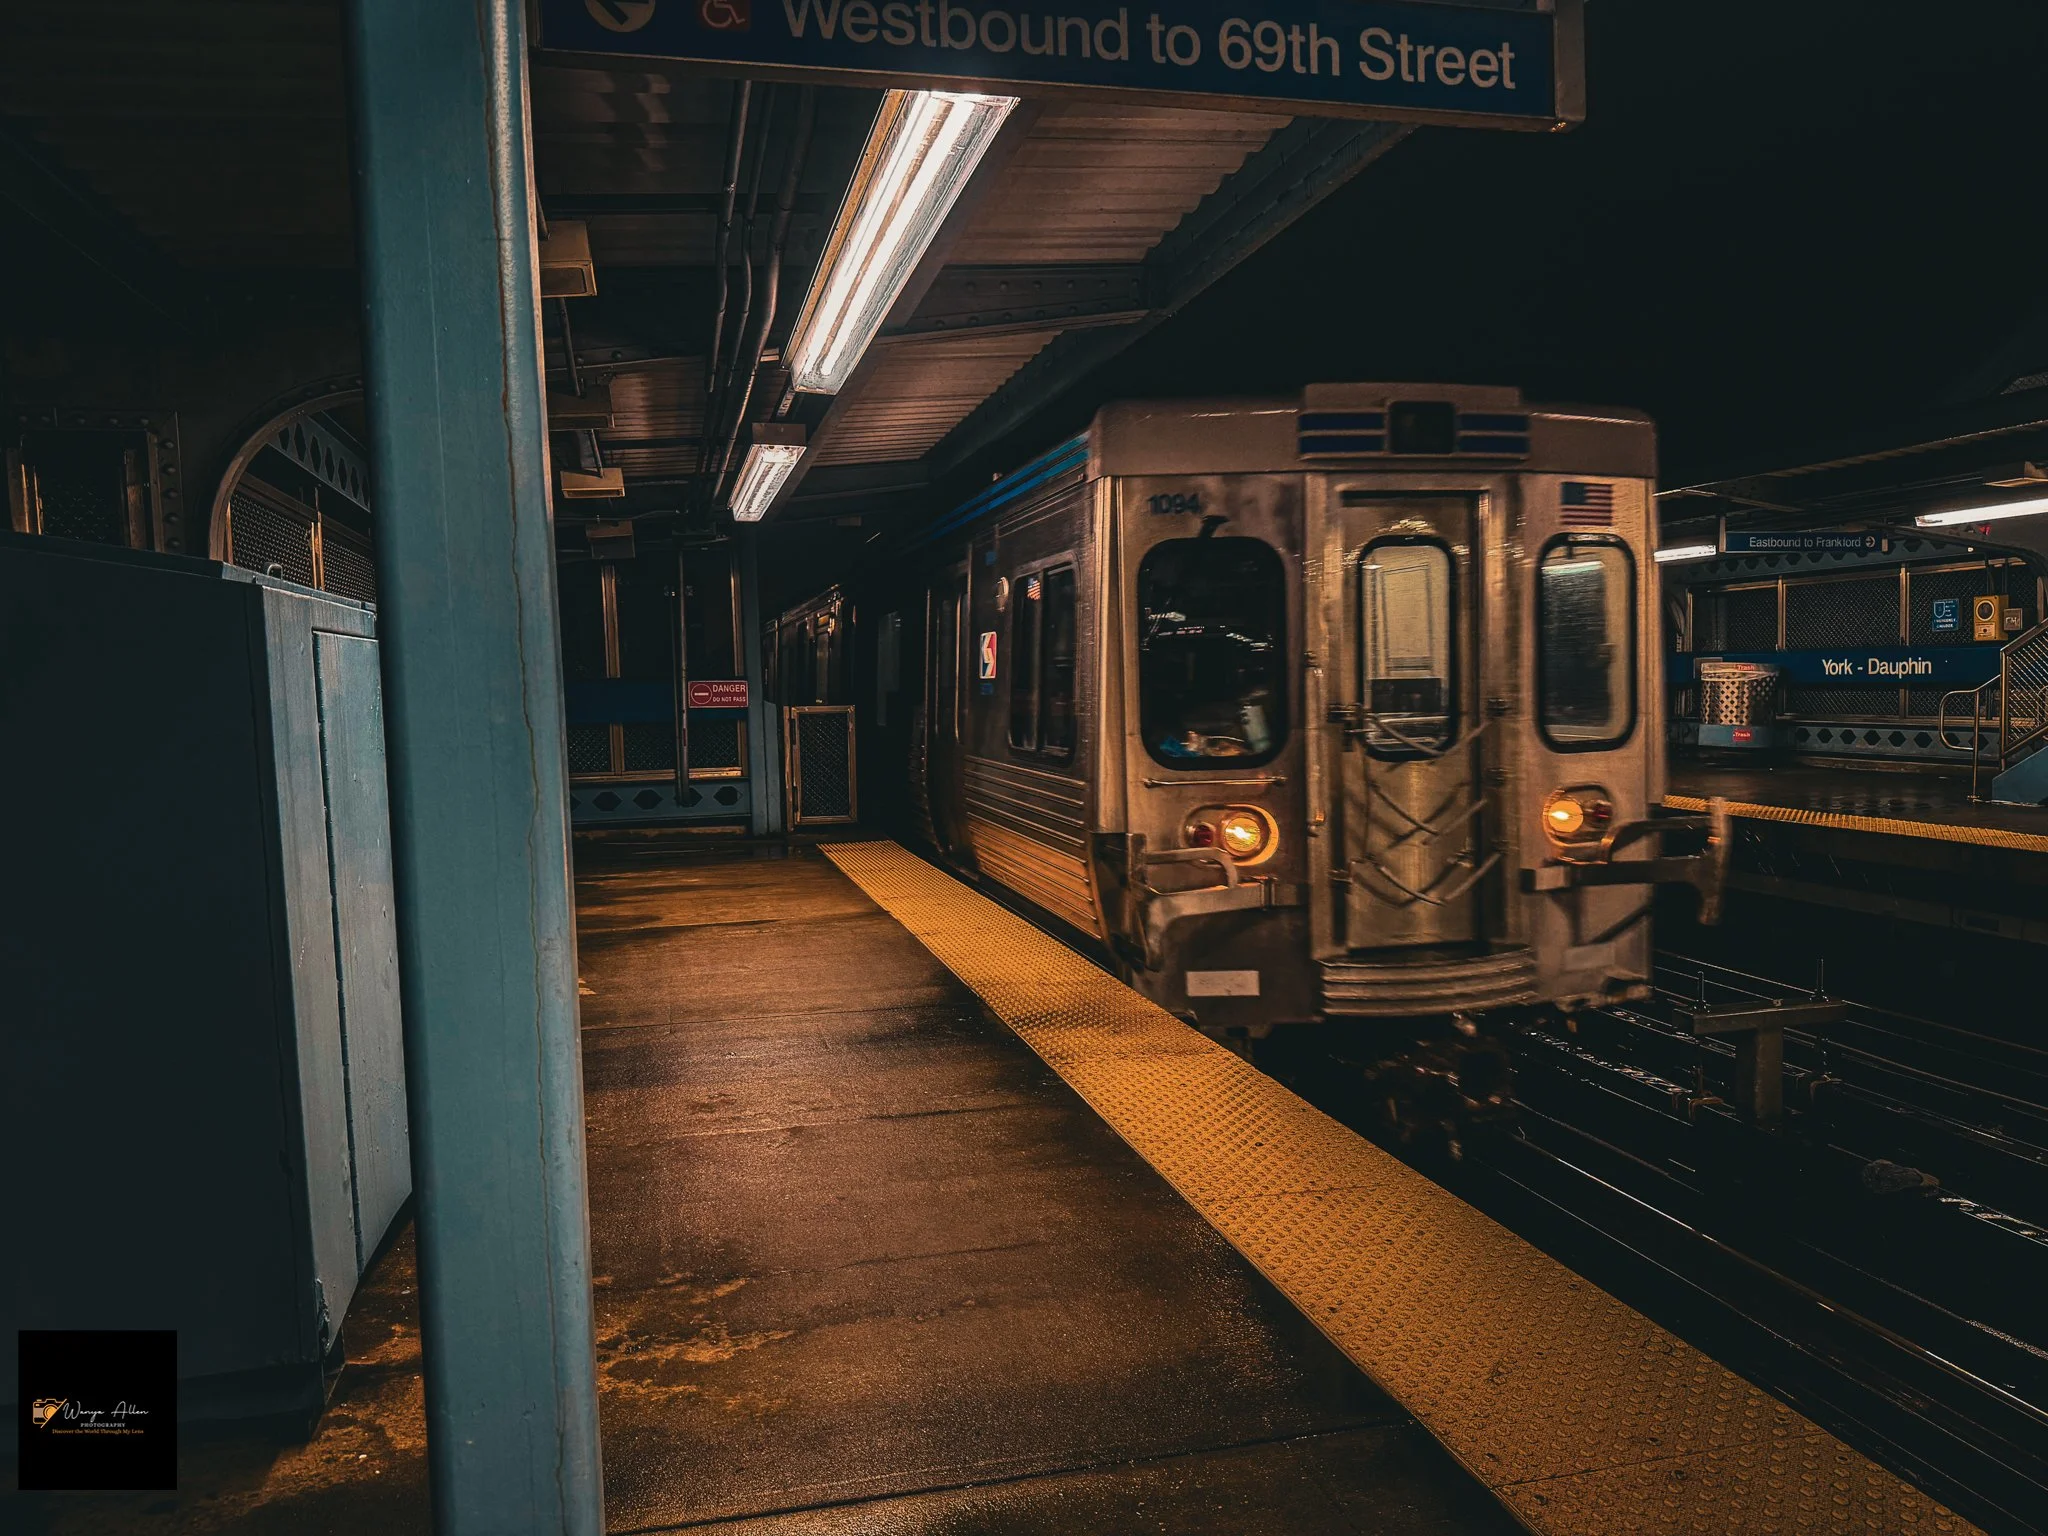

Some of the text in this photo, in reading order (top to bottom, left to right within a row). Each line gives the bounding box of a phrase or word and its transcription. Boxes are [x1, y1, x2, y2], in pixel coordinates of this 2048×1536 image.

[783, 0, 1516, 90] Westbound to 69th Street
[1146, 493, 1202, 515] 1094
[1749, 536, 1861, 548] Eastbound to Frankford
[1822, 658, 1853, 676] York
[1868, 657, 1932, 679] Dauphin
[712, 684, 746, 693] DANGER
